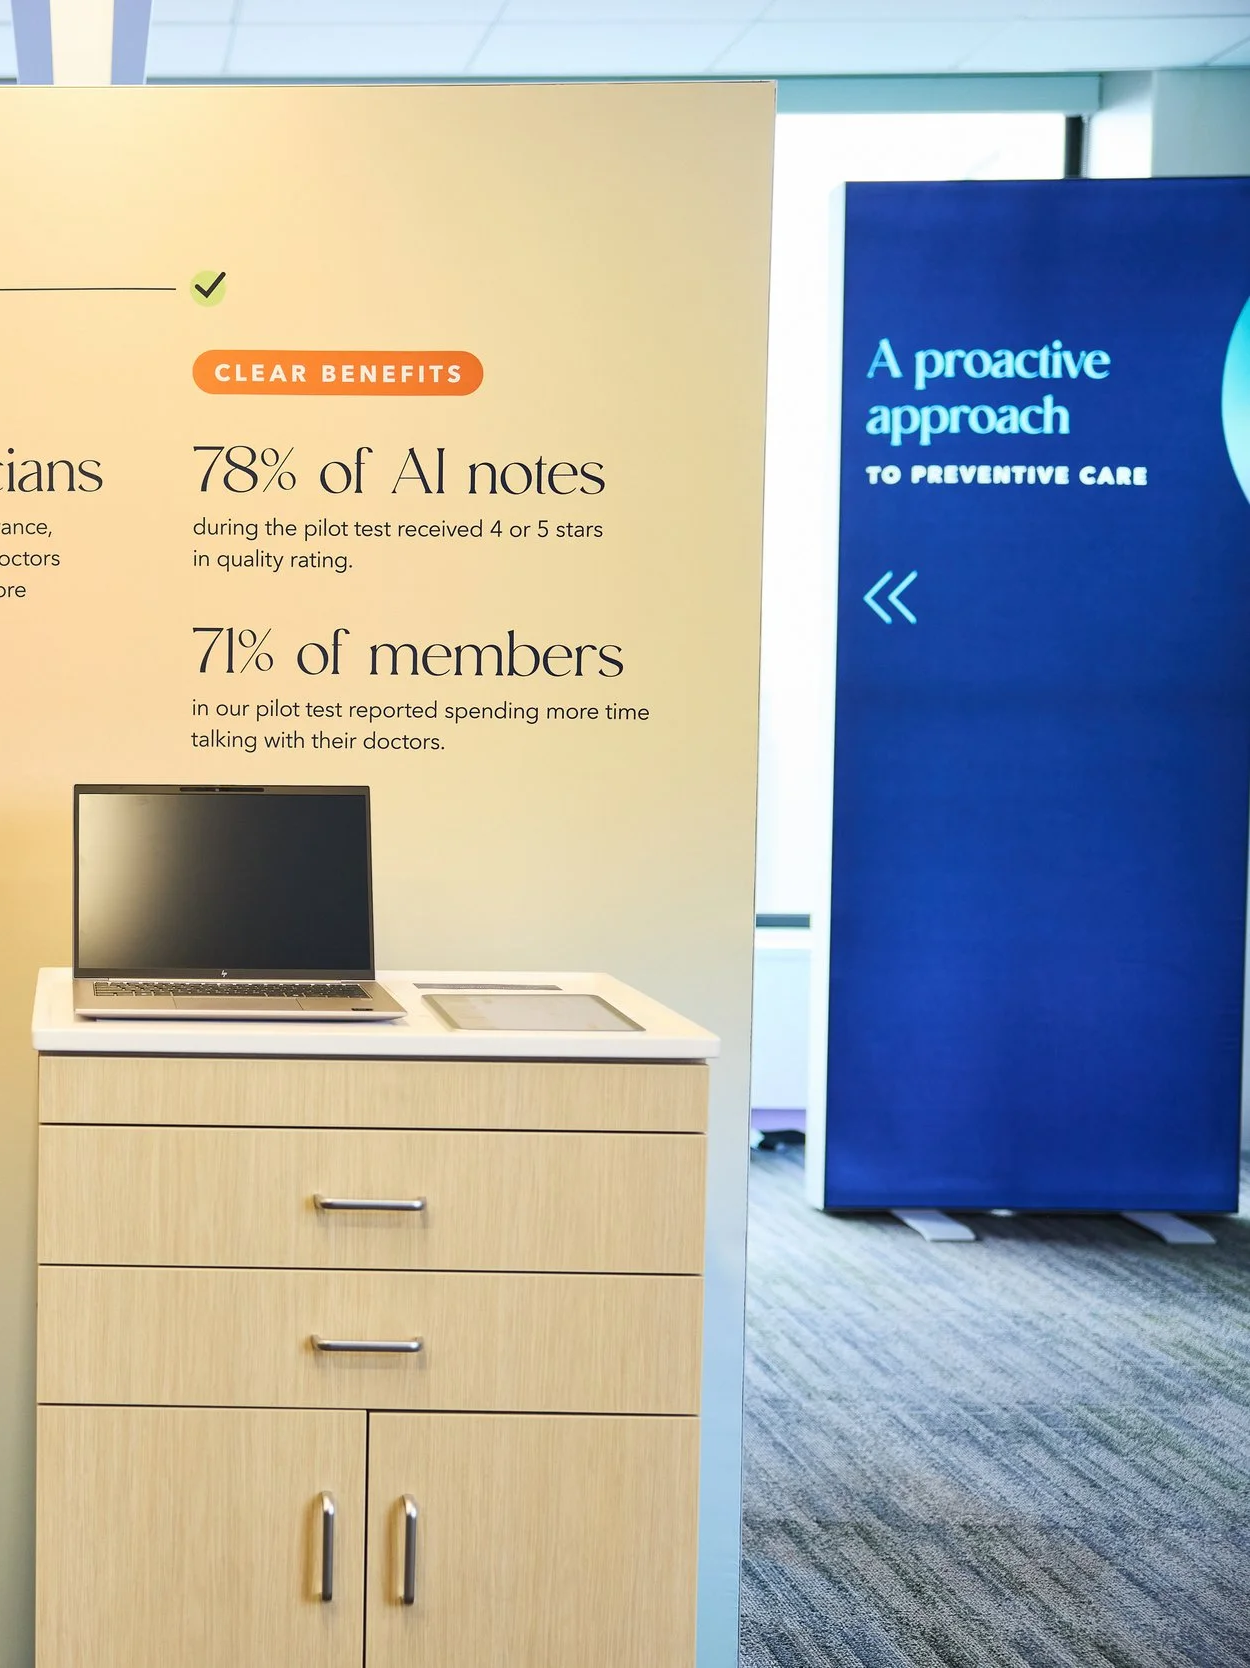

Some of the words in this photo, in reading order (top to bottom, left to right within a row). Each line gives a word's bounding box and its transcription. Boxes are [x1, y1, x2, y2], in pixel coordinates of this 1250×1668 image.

[215, 364, 306, 382] CLEAR
[322, 365, 460, 383] BENEFITS
[867, 338, 903, 378] A
[915, 340, 1111, 390] proactive
[866, 394, 1070, 446] approach
[193, 446, 296, 493] 78%
[320, 447, 373, 494] of
[392, 447, 445, 493] AI
[469, 456, 605, 495] notes
[866, 465, 901, 484] TO
[911, 465, 1069, 484] PREVENTIVE
[1079, 466, 1147, 485] CARE
[194, 517, 257, 540] during
[265, 518, 296, 536] the
[305, 518, 348, 541] pilot
[354, 522, 391, 537] test
[399, 519, 482, 537] received
[490, 520, 502, 537] 4
[510, 526, 531, 537] or
[538, 520, 548, 537] 5
[557, 523, 603, 537] stars
[194, 550, 209, 566] in
[218, 549, 283, 572] quality
[291, 551, 352, 573] rating.
[193, 628, 273, 673] 71%
[297, 628, 350, 675] of
[370, 630, 623, 677] members
[191, 729, 256, 753] talking
[264, 730, 304, 748] with
[311, 731, 357, 748] their
[364, 731, 444, 749] doctors.
